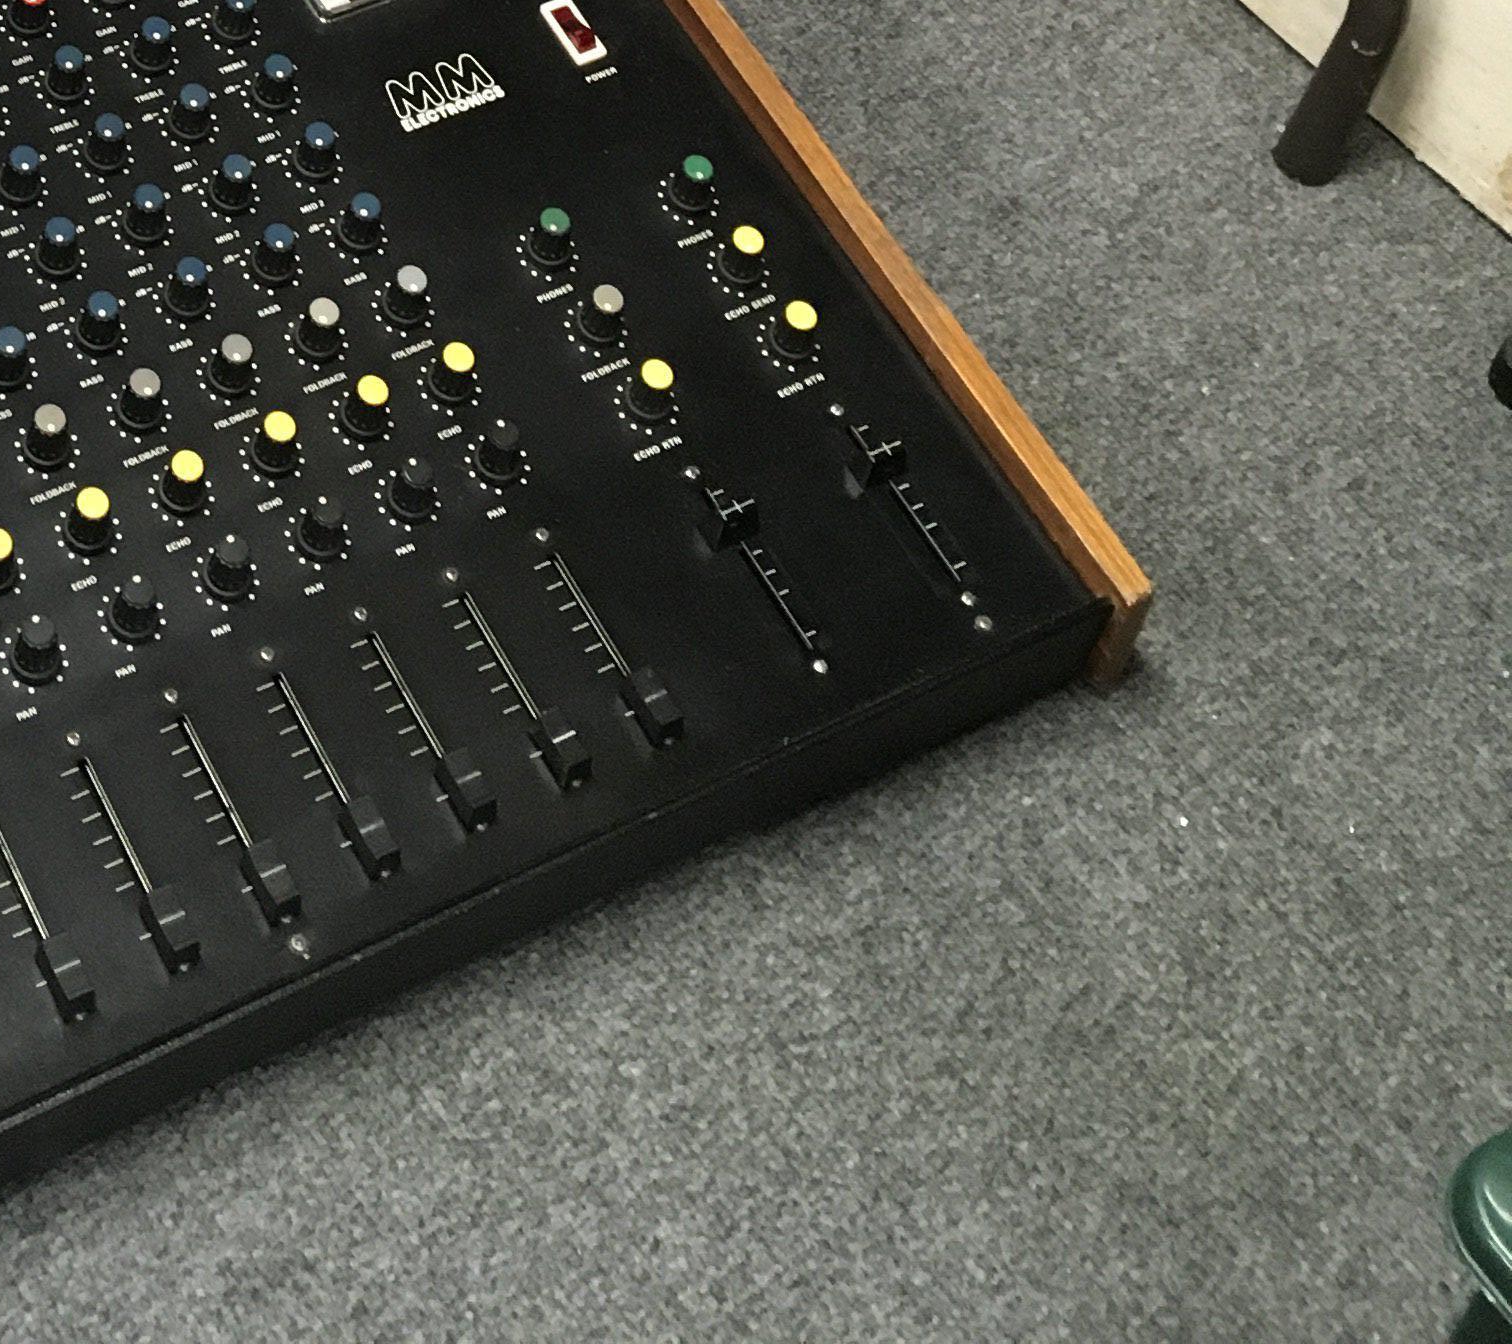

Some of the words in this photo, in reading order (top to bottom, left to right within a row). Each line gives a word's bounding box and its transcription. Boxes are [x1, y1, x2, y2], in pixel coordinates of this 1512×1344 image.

[585, 67, 617, 83] POWER
[385, 52, 496, 119] MM
[399, 84, 506, 134] ELECTRONICS
[678, 230, 713, 248] PHONES
[344, 272, 367, 285] BASS
[537, 284, 573, 303] PHONES
[724, 305, 750, 320] ECHO
[751, 295, 776, 309] SEND
[392, 339, 434, 360] FOLDBACK
[581, 358, 630, 382] FOLDBACK
[80, 375, 104, 388] BASS
[303, 372, 347, 393] FOLDBACK
[777, 382, 803, 398] ECHO
[804, 373, 825, 386] RTN
[214, 408, 258, 429] FOLDBACK
[437, 425, 462, 440] ECHO
[123, 445, 169, 469] FOLDBACK
[634, 445, 660, 461] ECHO
[662, 436, 682, 449] RTN
[348, 460, 372, 475] ECHO
[30, 482, 76, 505] FOLDBACK
[258, 497, 283, 512] ECHO
[166, 537, 191, 552] ECHO
[395, 544, 415, 556] PAN
[71, 575, 97, 591] ECHO
